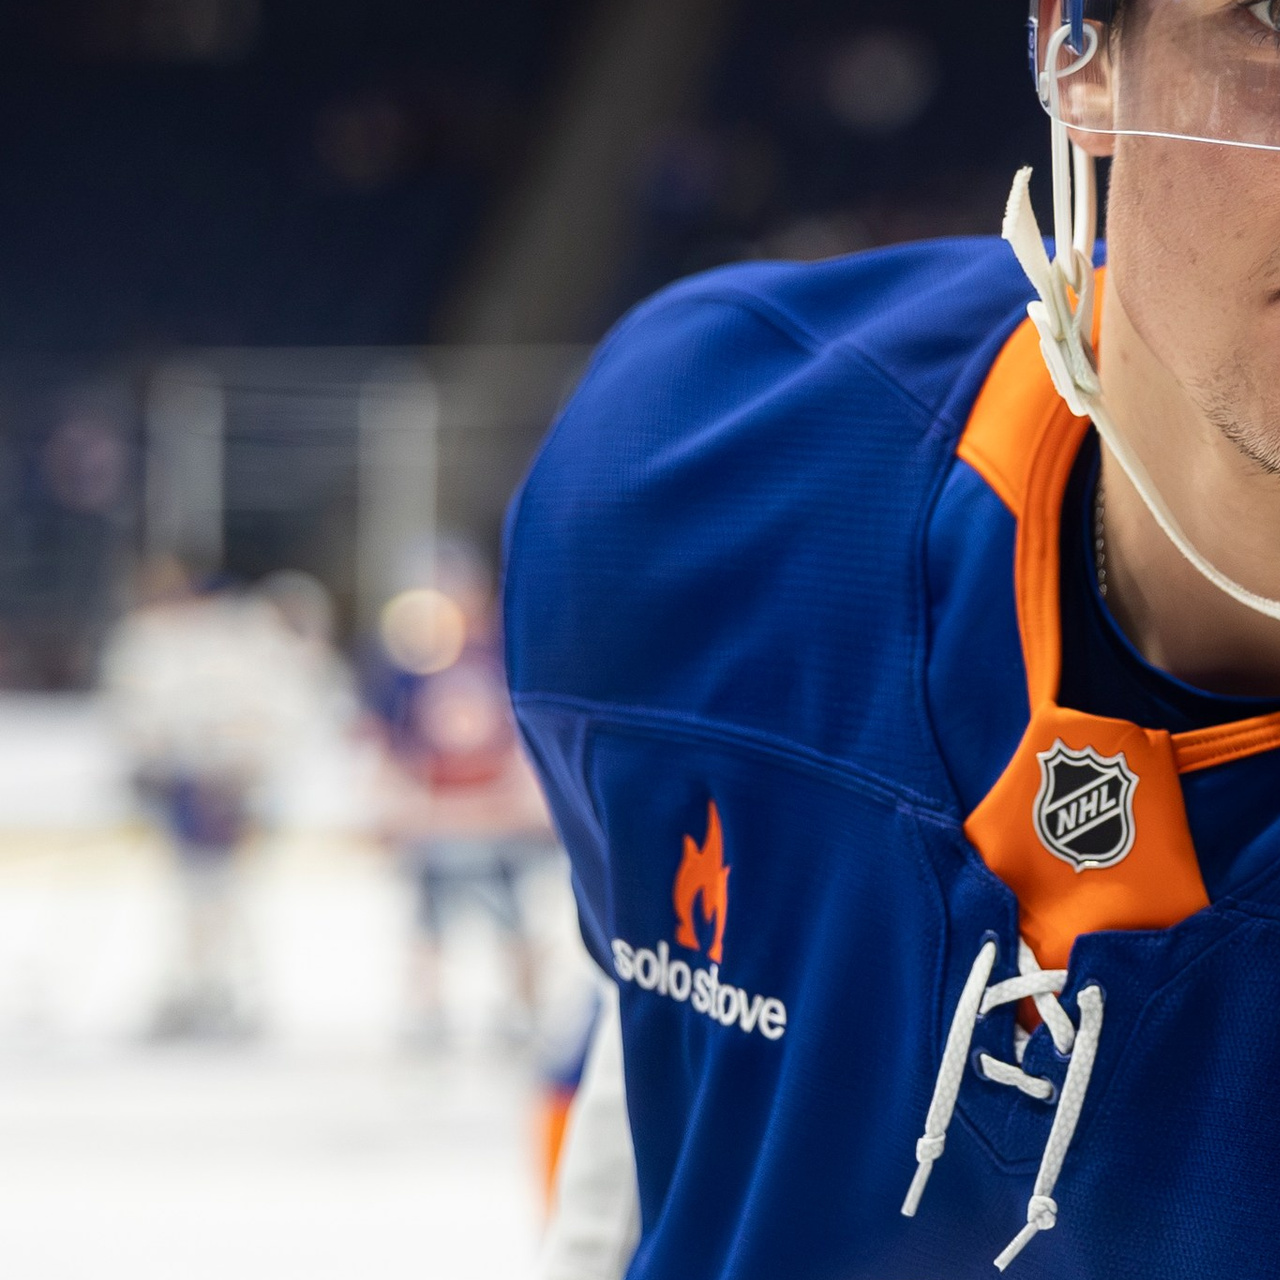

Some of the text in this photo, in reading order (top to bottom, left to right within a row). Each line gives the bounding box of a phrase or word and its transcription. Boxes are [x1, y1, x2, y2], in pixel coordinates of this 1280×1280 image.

[1056, 783, 1117, 837] NHL
[610, 937, 788, 1042] solo stove
